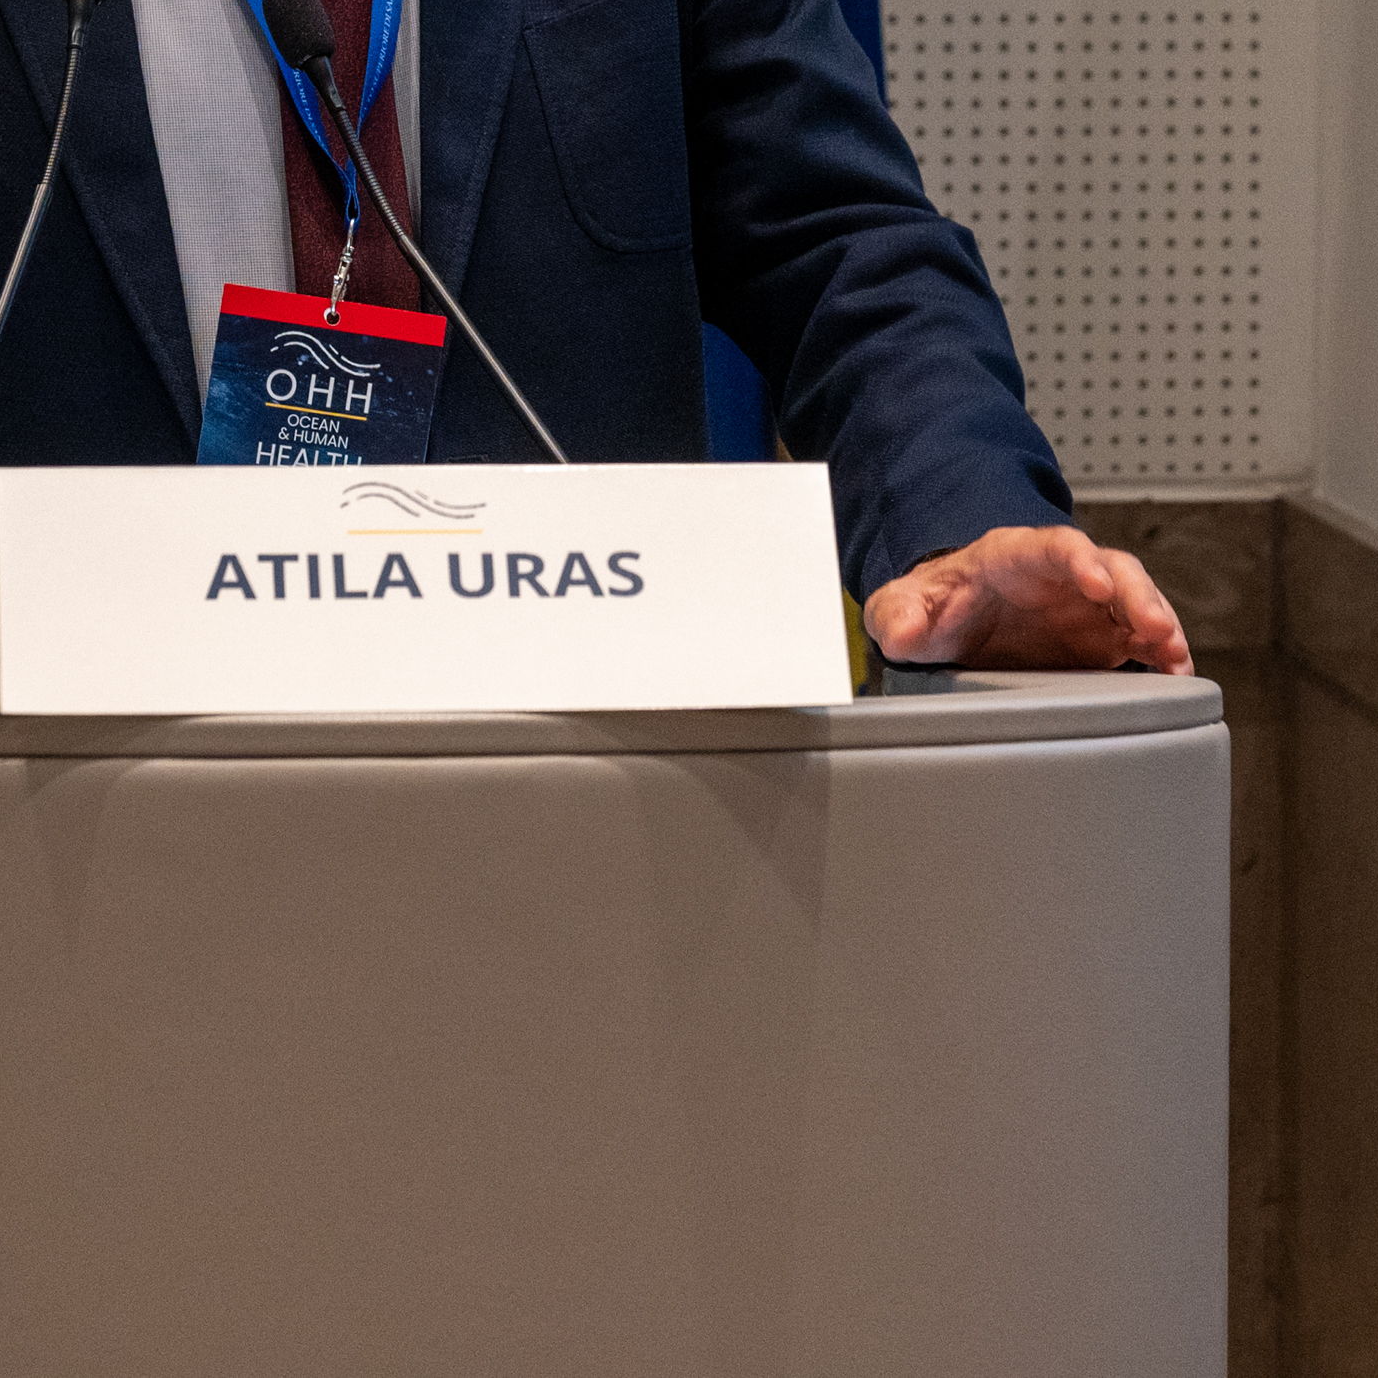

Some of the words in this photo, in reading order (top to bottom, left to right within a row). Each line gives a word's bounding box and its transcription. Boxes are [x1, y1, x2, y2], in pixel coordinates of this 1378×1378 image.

[265, 368, 373, 415] OHH
[278, 426, 290, 441] &
[293, 428, 349, 450] HUMAN
[287, 413, 341, 434] OCEAN
[205, 552, 424, 601] ATILA
[447, 551, 645, 599] URAS
